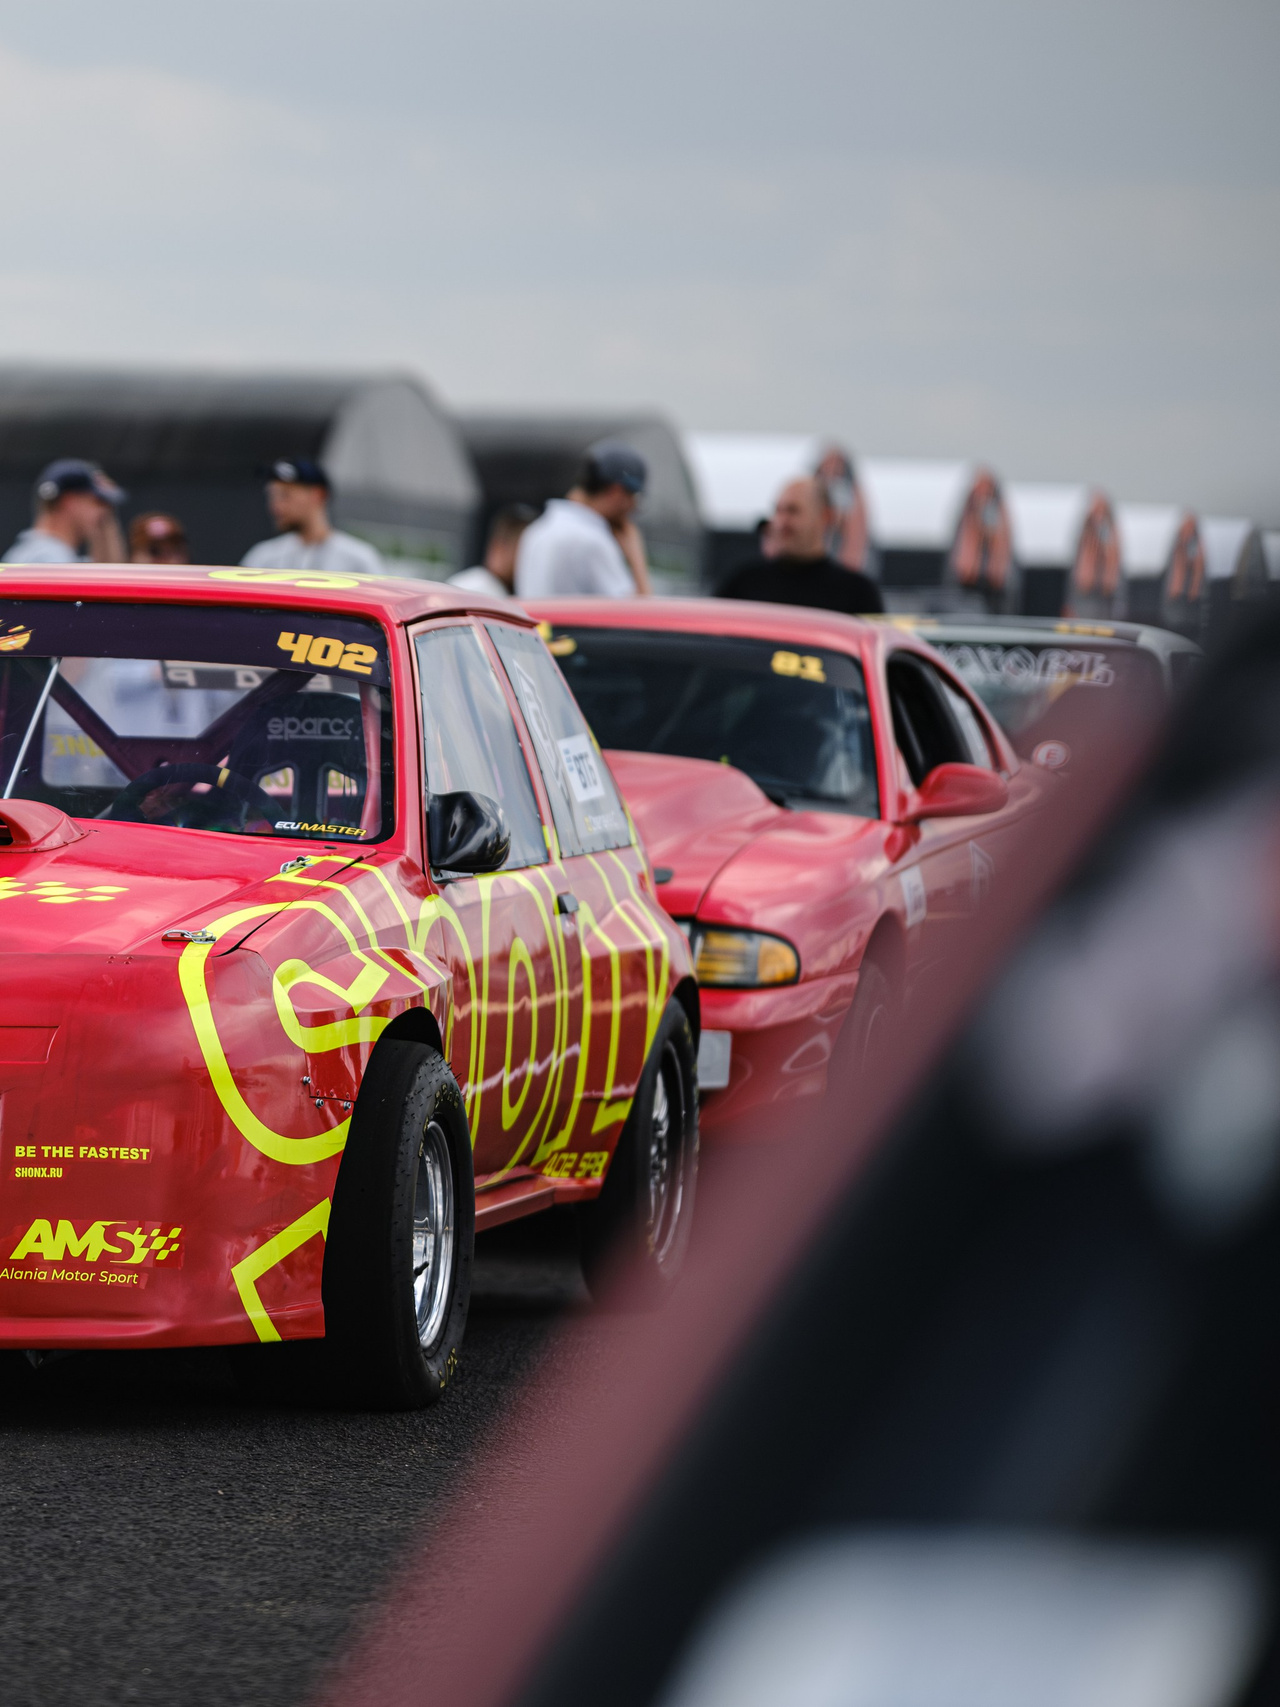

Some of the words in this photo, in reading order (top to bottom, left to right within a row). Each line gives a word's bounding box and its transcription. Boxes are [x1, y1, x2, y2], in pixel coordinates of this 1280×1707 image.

[277, 631, 378, 675] 402
[15, 1146, 36, 1158] BE
[41, 1146, 74, 1158] THE
[79, 1146, 150, 1160] FASTEST
[542, 1152, 578, 1178] 402
[574, 1150, 609, 1178] SPB
[15, 1167, 63, 1178] SHONX.RU
[9, 1218, 152, 1264] AMS
[51, 1269, 95, 1282] Motor
[99, 1270, 139, 1285] Sport
